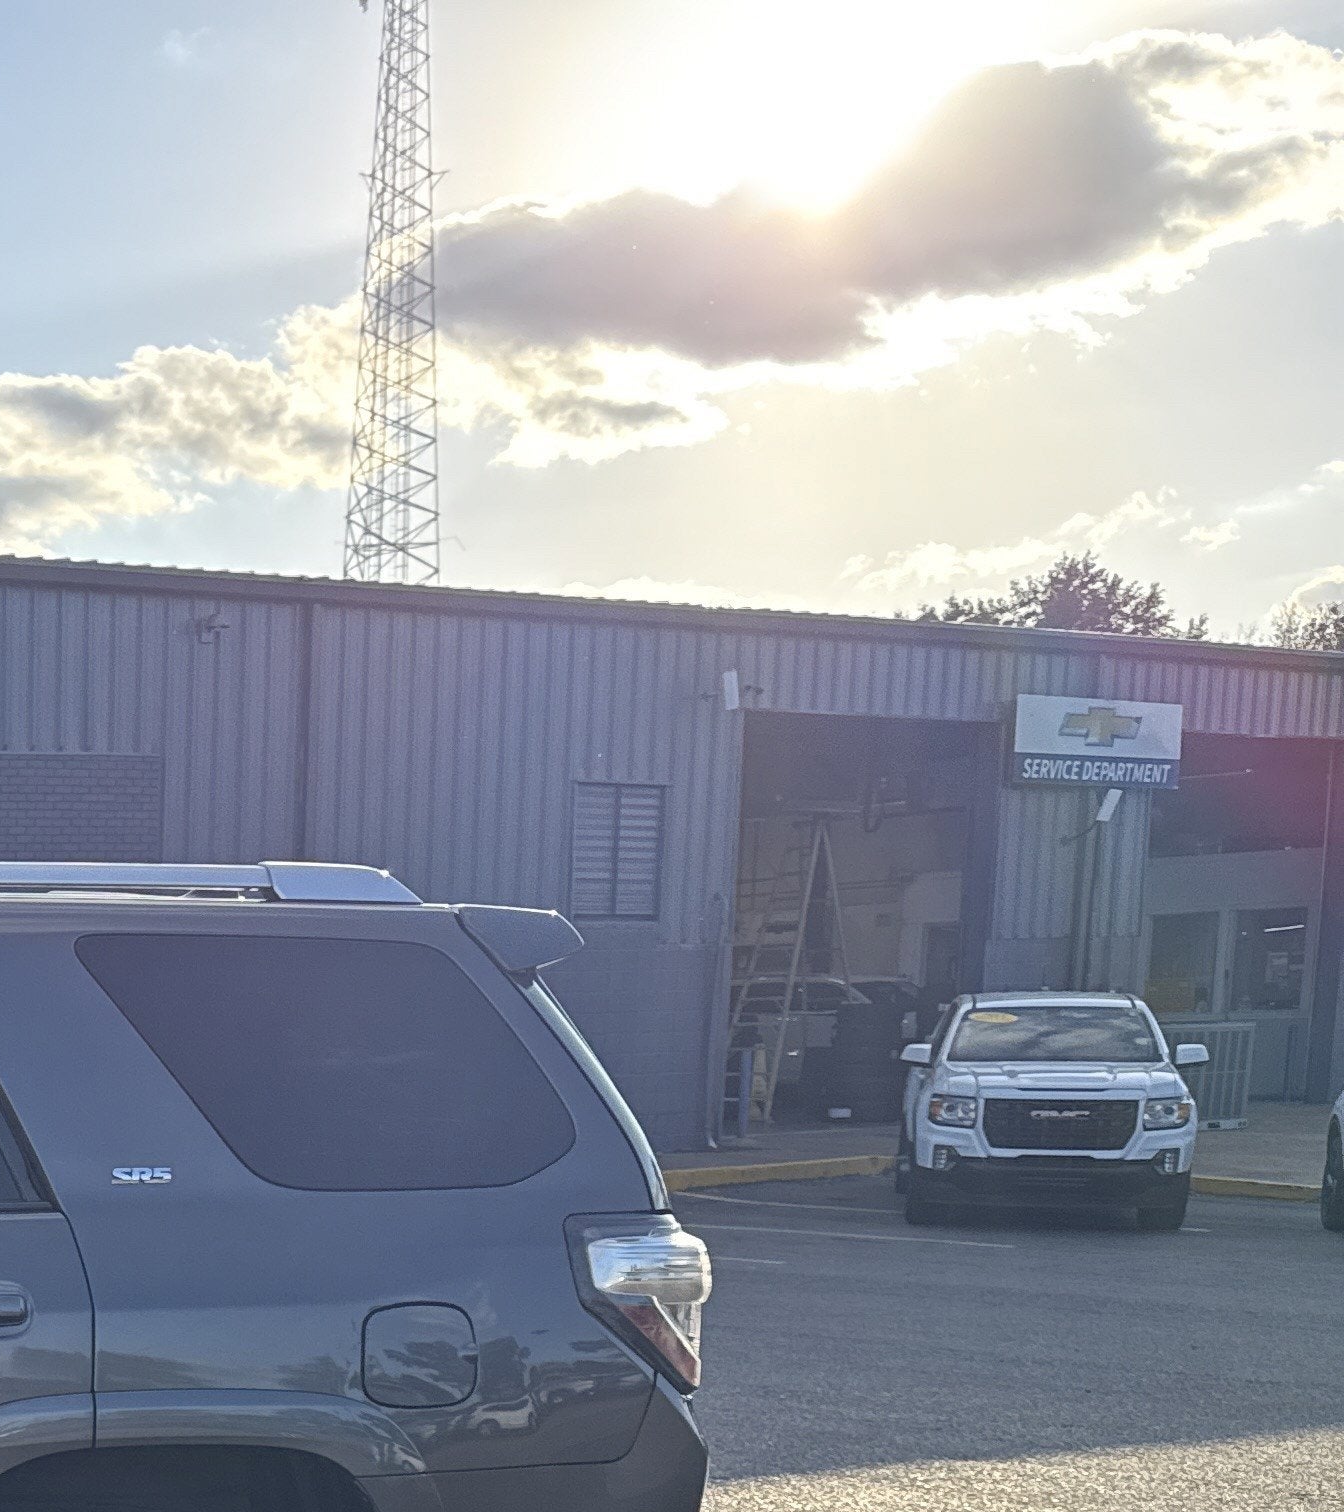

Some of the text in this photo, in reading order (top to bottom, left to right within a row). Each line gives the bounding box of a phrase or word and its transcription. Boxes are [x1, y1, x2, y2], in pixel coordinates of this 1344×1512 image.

[1021, 757, 1172, 785] SERVICE DEPARTMENT
[111, 1167, 172, 1185] SR5
